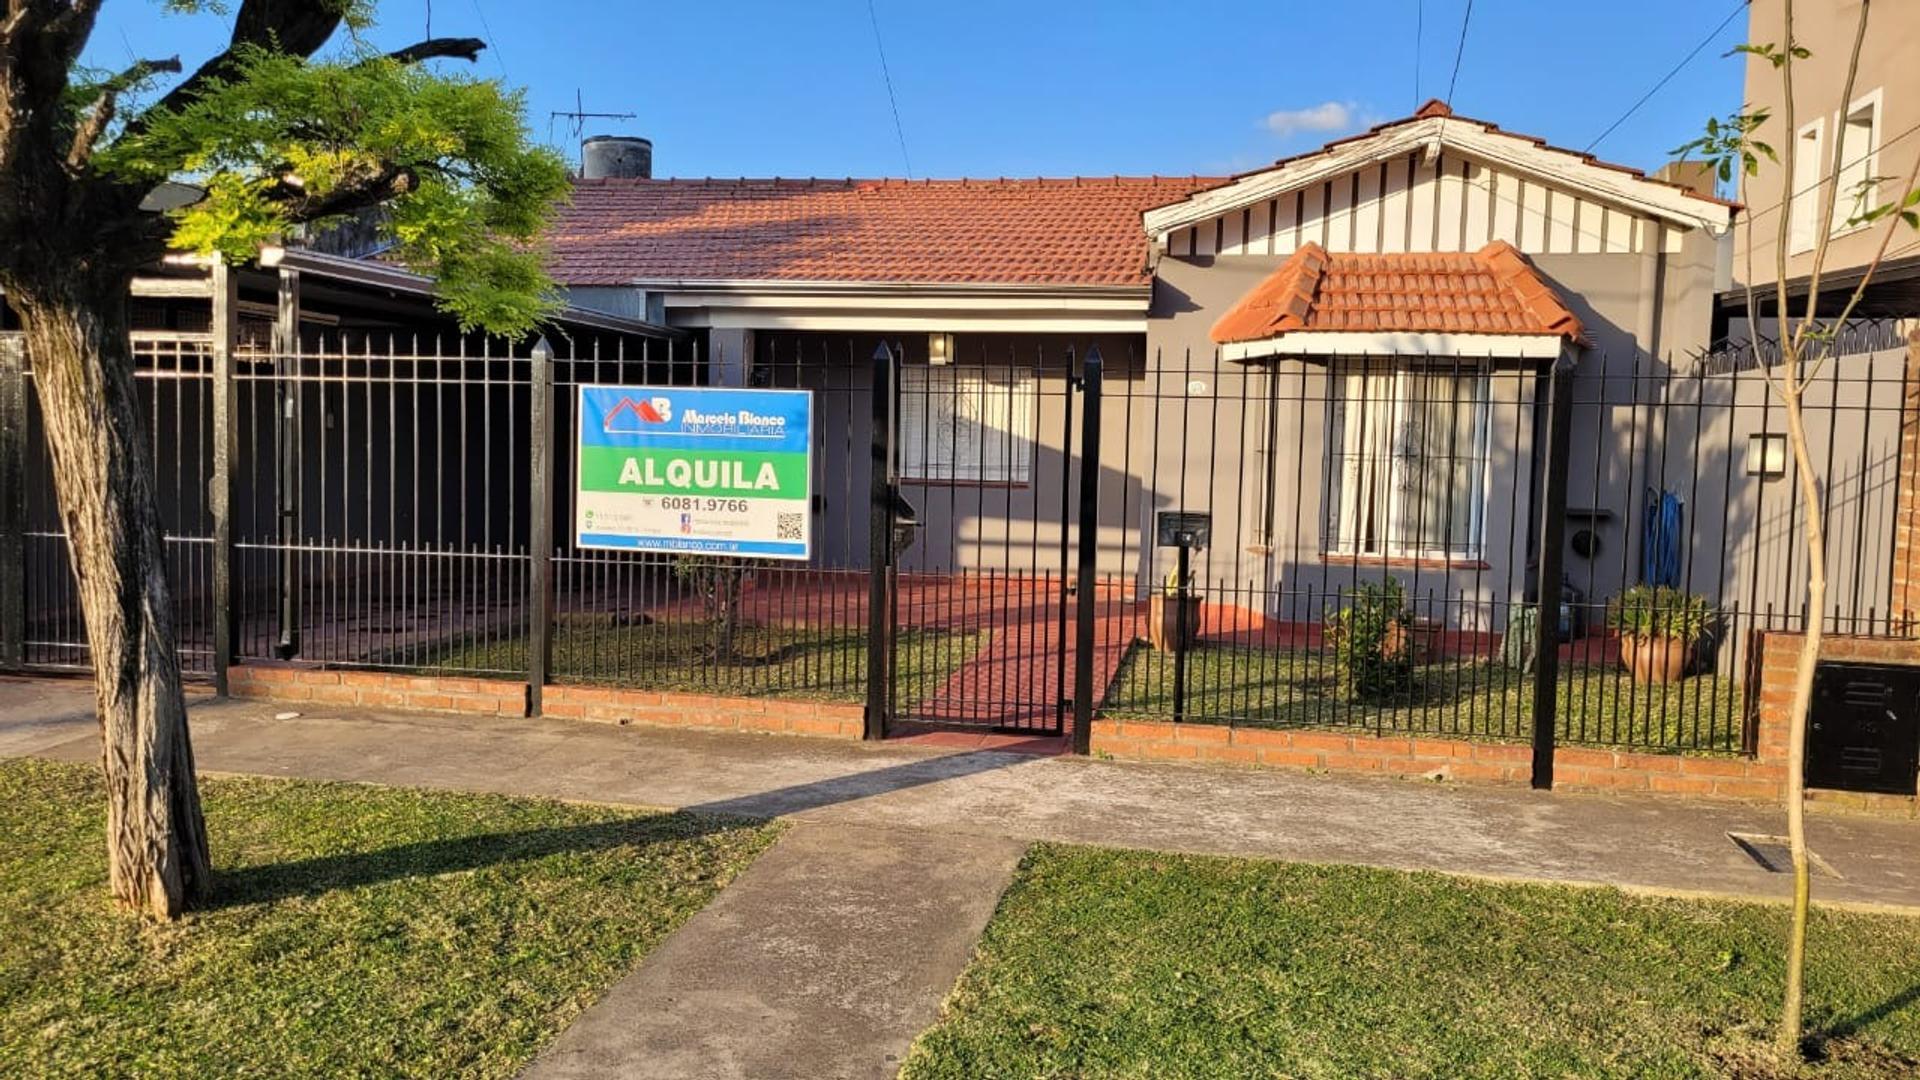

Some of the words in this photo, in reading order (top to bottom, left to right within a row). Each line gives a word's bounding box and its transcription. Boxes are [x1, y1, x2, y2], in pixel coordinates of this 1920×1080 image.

[738, 411, 786, 425] Bianco
[618, 457, 780, 490] ALQUILA
[661, 497, 748, 512] 6081.9766
